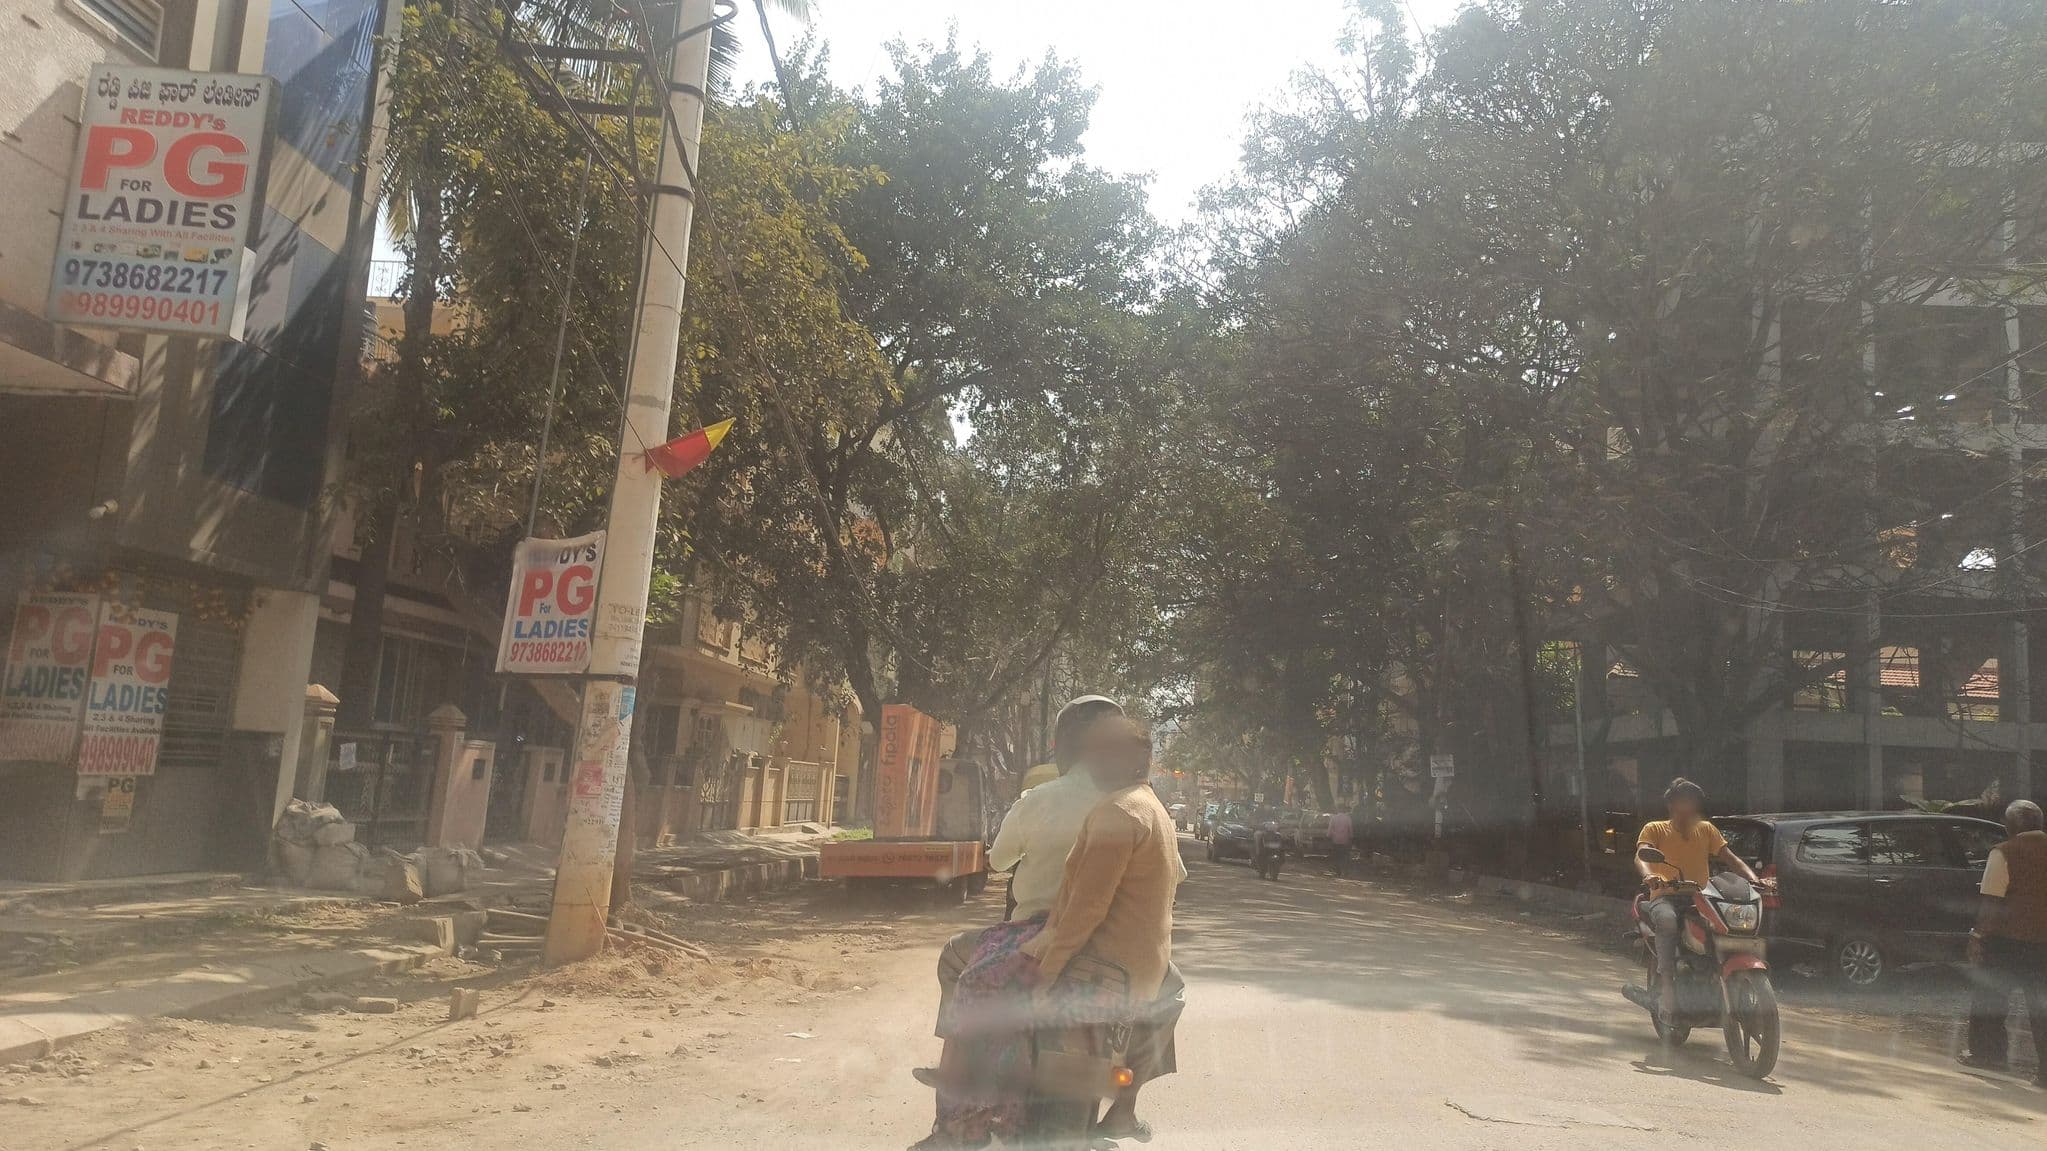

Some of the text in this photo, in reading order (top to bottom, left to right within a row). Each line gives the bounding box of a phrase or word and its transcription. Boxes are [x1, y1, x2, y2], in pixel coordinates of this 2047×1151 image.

[120, 107, 226, 131] REDDY's
[79, 124, 248, 199] PG
[120, 179, 152, 192] FOR
[78, 194, 237, 230] LADIES
[64, 258, 228, 296] 9738682217
[59, 290, 220, 326] 989990401
[518, 565, 594, 617] PG
[539, 602, 551, 615] For
[11, 605, 93, 665] PG
[514, 618, 589, 639] LADIES
[30, 648, 49, 659] FOR
[93, 624, 175, 684] PG
[113, 664, 133, 676] FOR
[6, 664, 86, 699] LADIES
[89, 682, 169, 714] LADIES
[109, 777, 135, 793] PG
